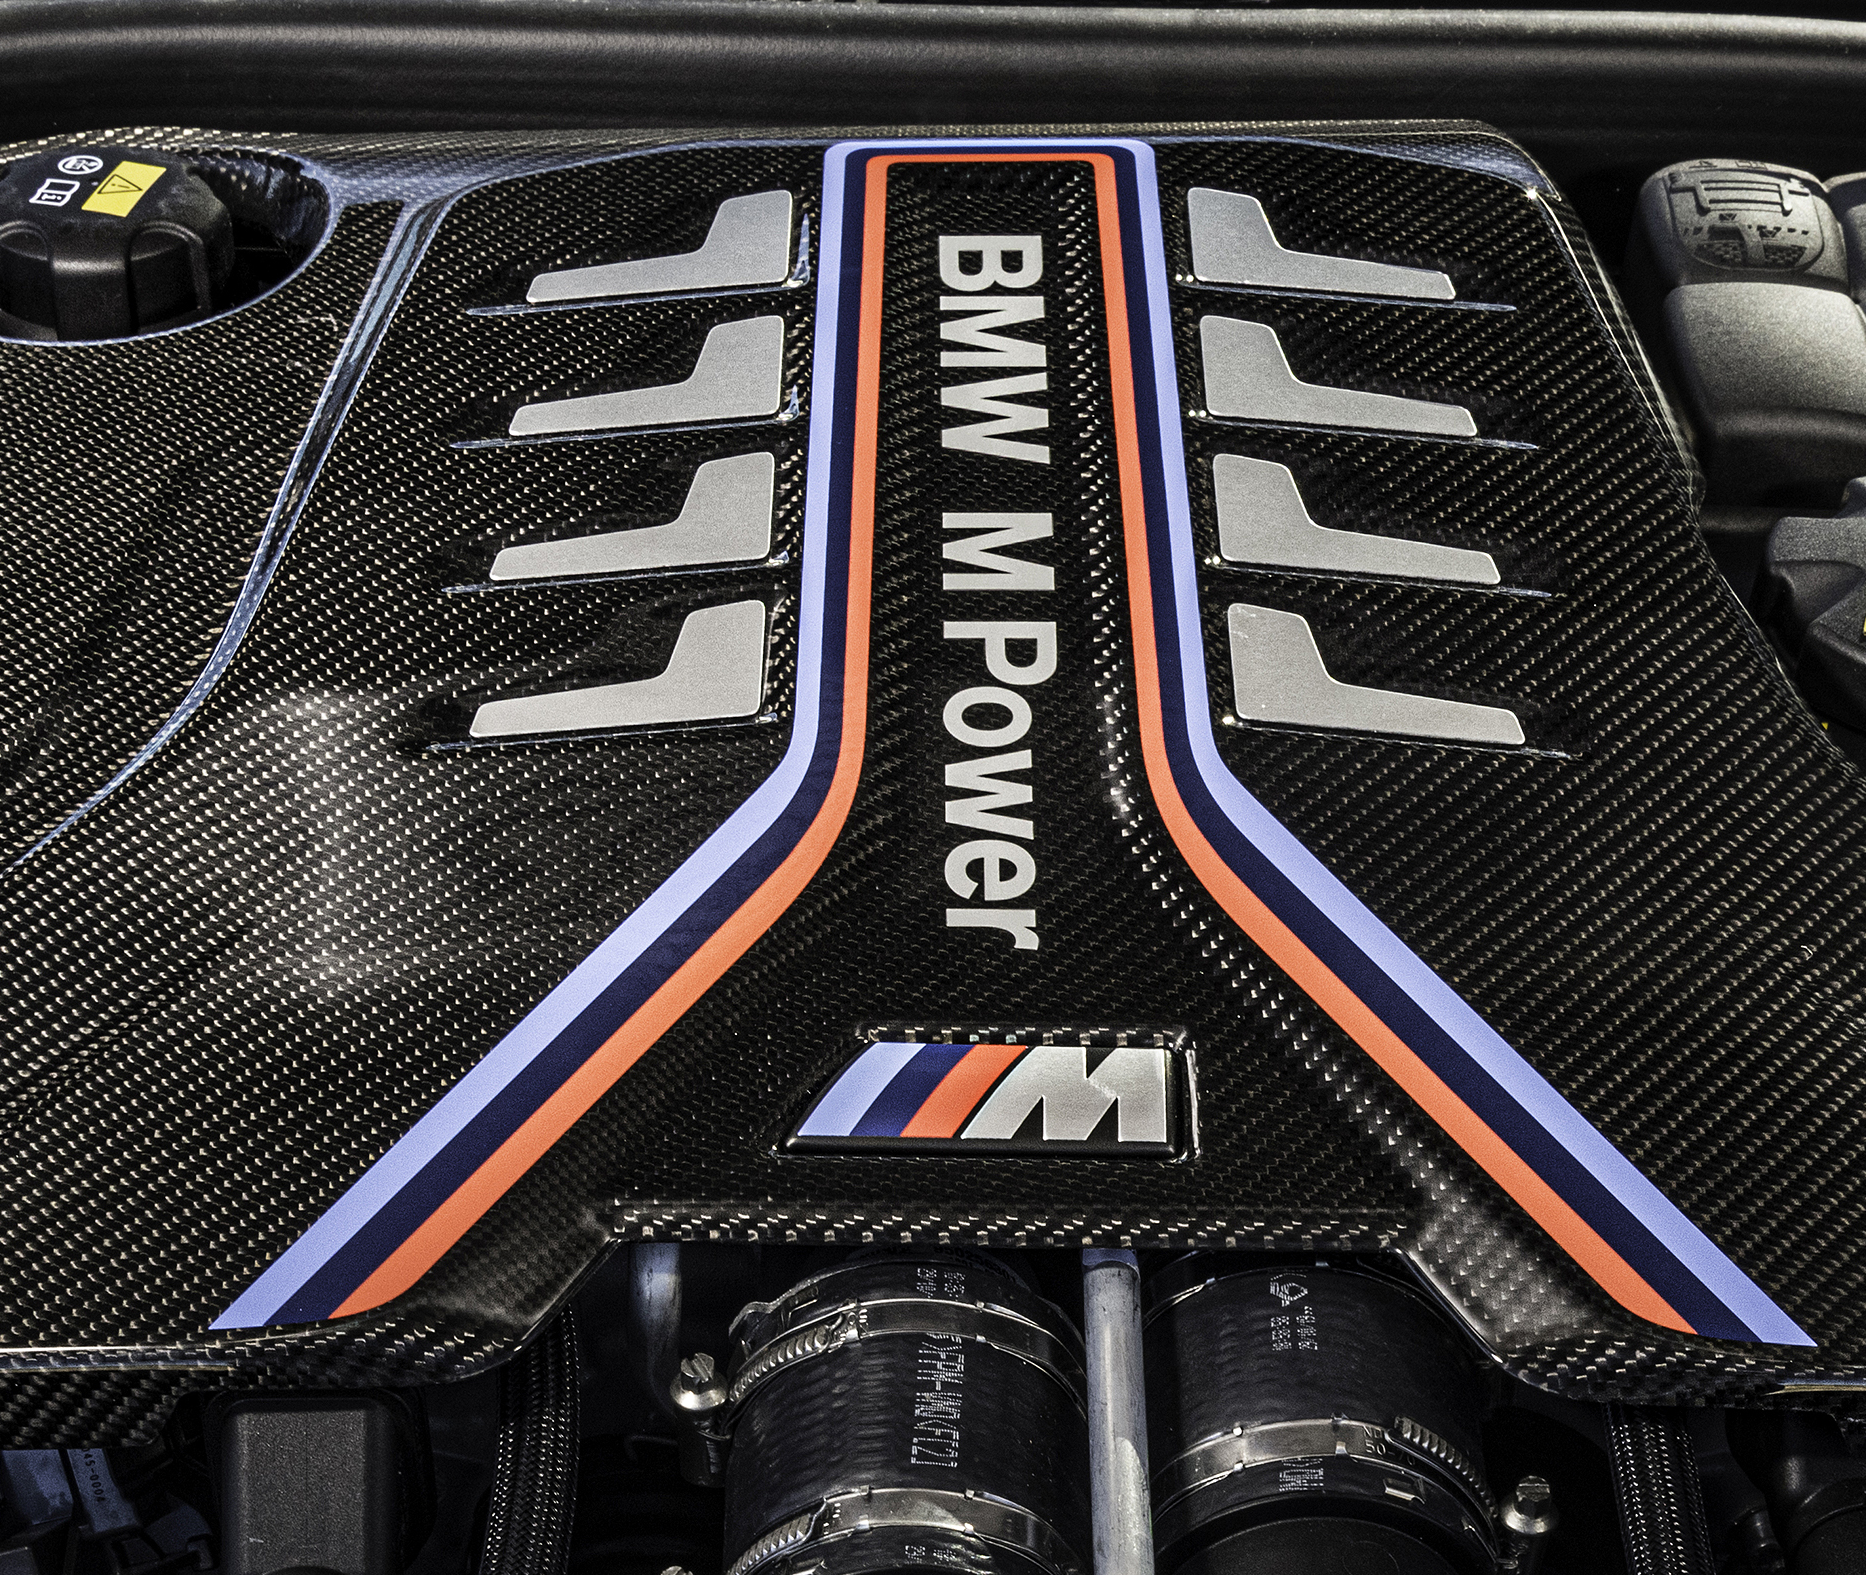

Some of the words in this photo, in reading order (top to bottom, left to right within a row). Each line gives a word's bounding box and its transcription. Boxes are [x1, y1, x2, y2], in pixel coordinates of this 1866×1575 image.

[938, 235, 1051, 464] BMW
[942, 512, 1055, 591] M
[942, 620, 1058, 951] Power
[960, 1045, 1167, 1144] M
